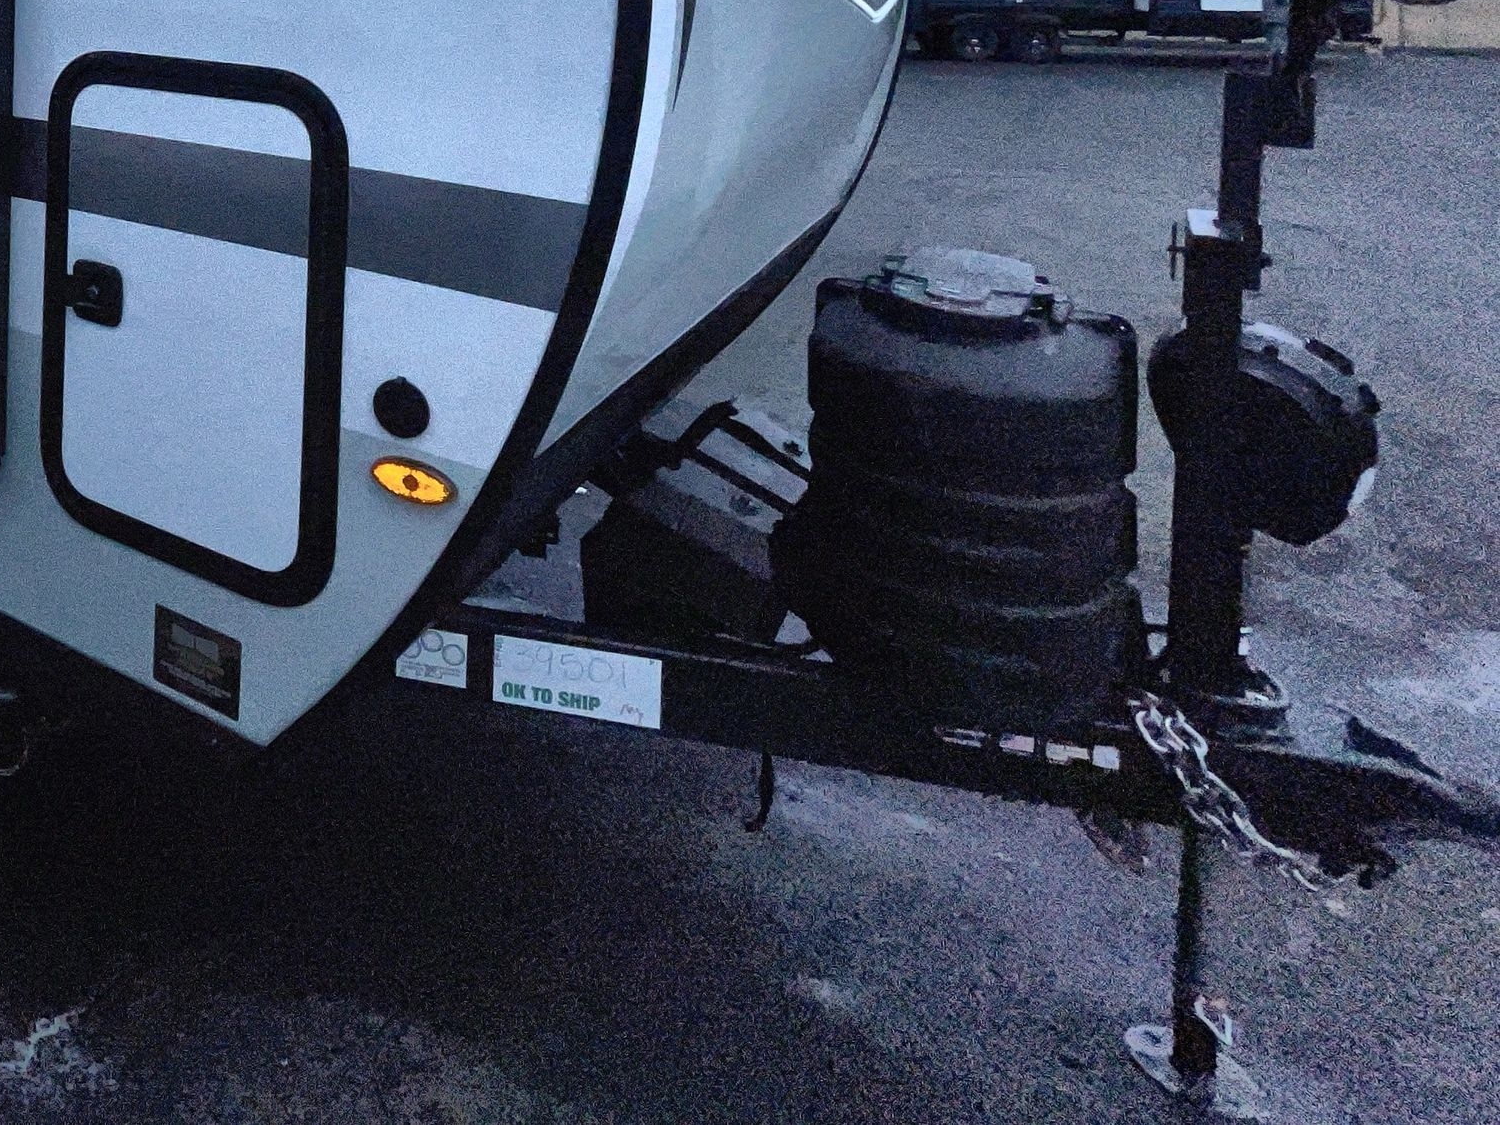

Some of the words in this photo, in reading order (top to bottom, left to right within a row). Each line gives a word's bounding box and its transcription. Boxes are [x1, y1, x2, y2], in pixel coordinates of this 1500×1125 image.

[501, 682, 526, 700] OK
[531, 686, 553, 704] TO
[558, 691, 601, 711] SHIP
